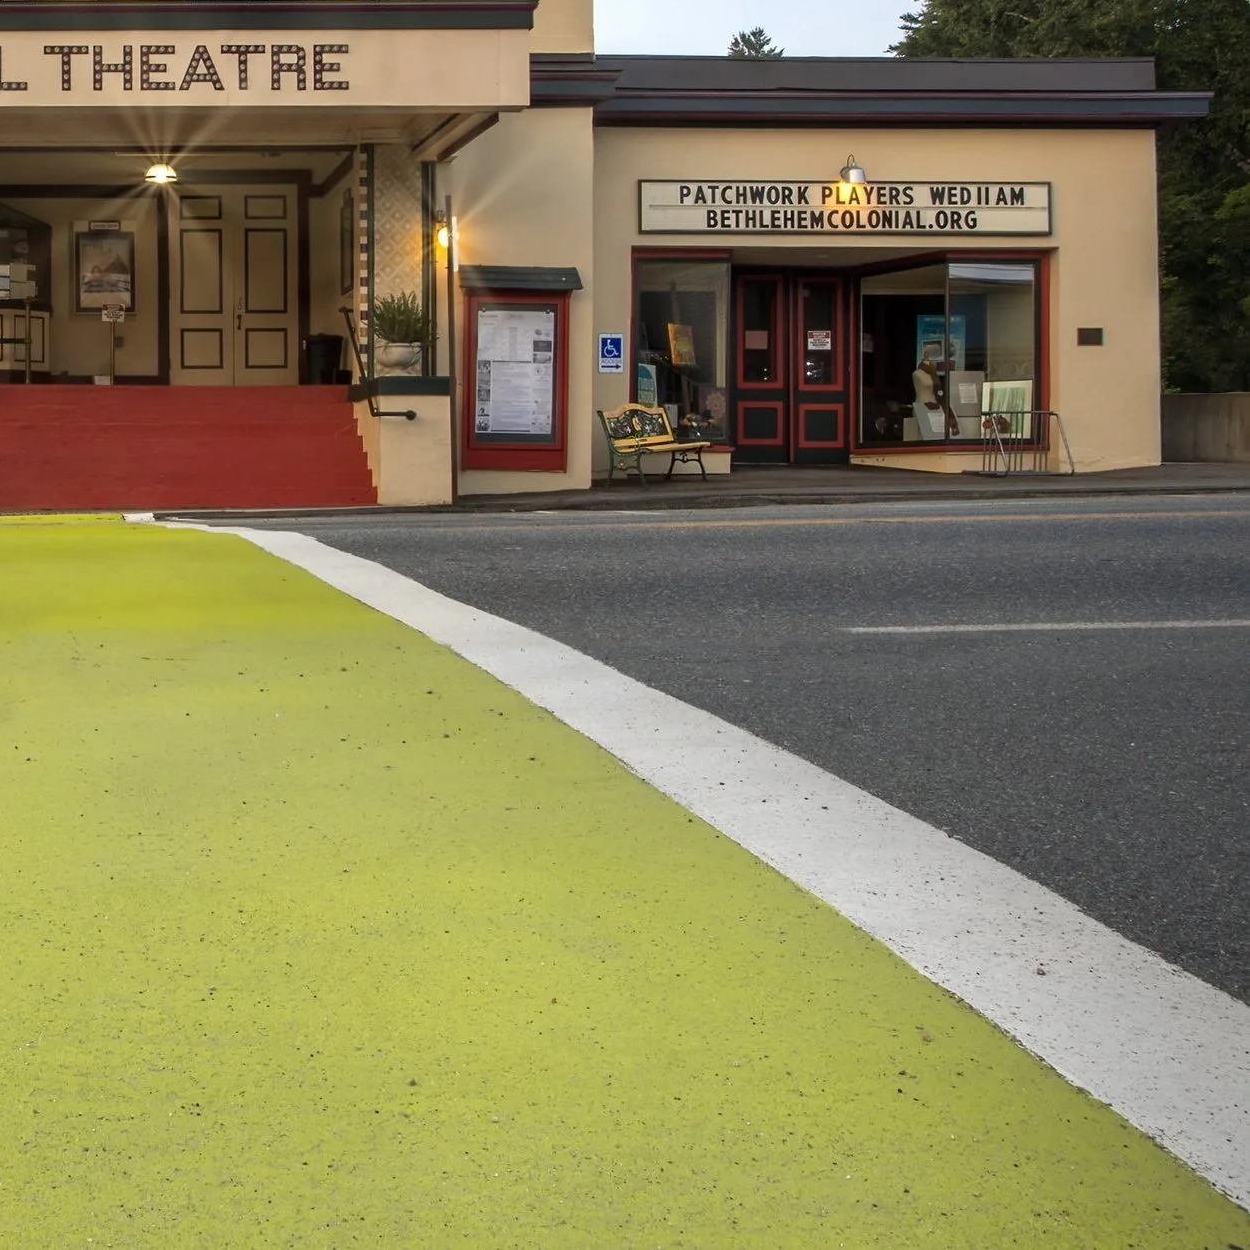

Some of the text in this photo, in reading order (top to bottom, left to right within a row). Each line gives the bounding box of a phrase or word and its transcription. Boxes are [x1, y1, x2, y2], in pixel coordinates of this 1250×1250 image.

[44, 44, 350, 91] THEATRE
[679, 185, 810, 205] PATCHWORK
[821, 186, 914, 205] PLAYERS
[929, 186, 972, 205] WED
[995, 187, 1025, 205] AM
[706, 210, 978, 229] BETHLEHEMCOLONIAL.ORG
